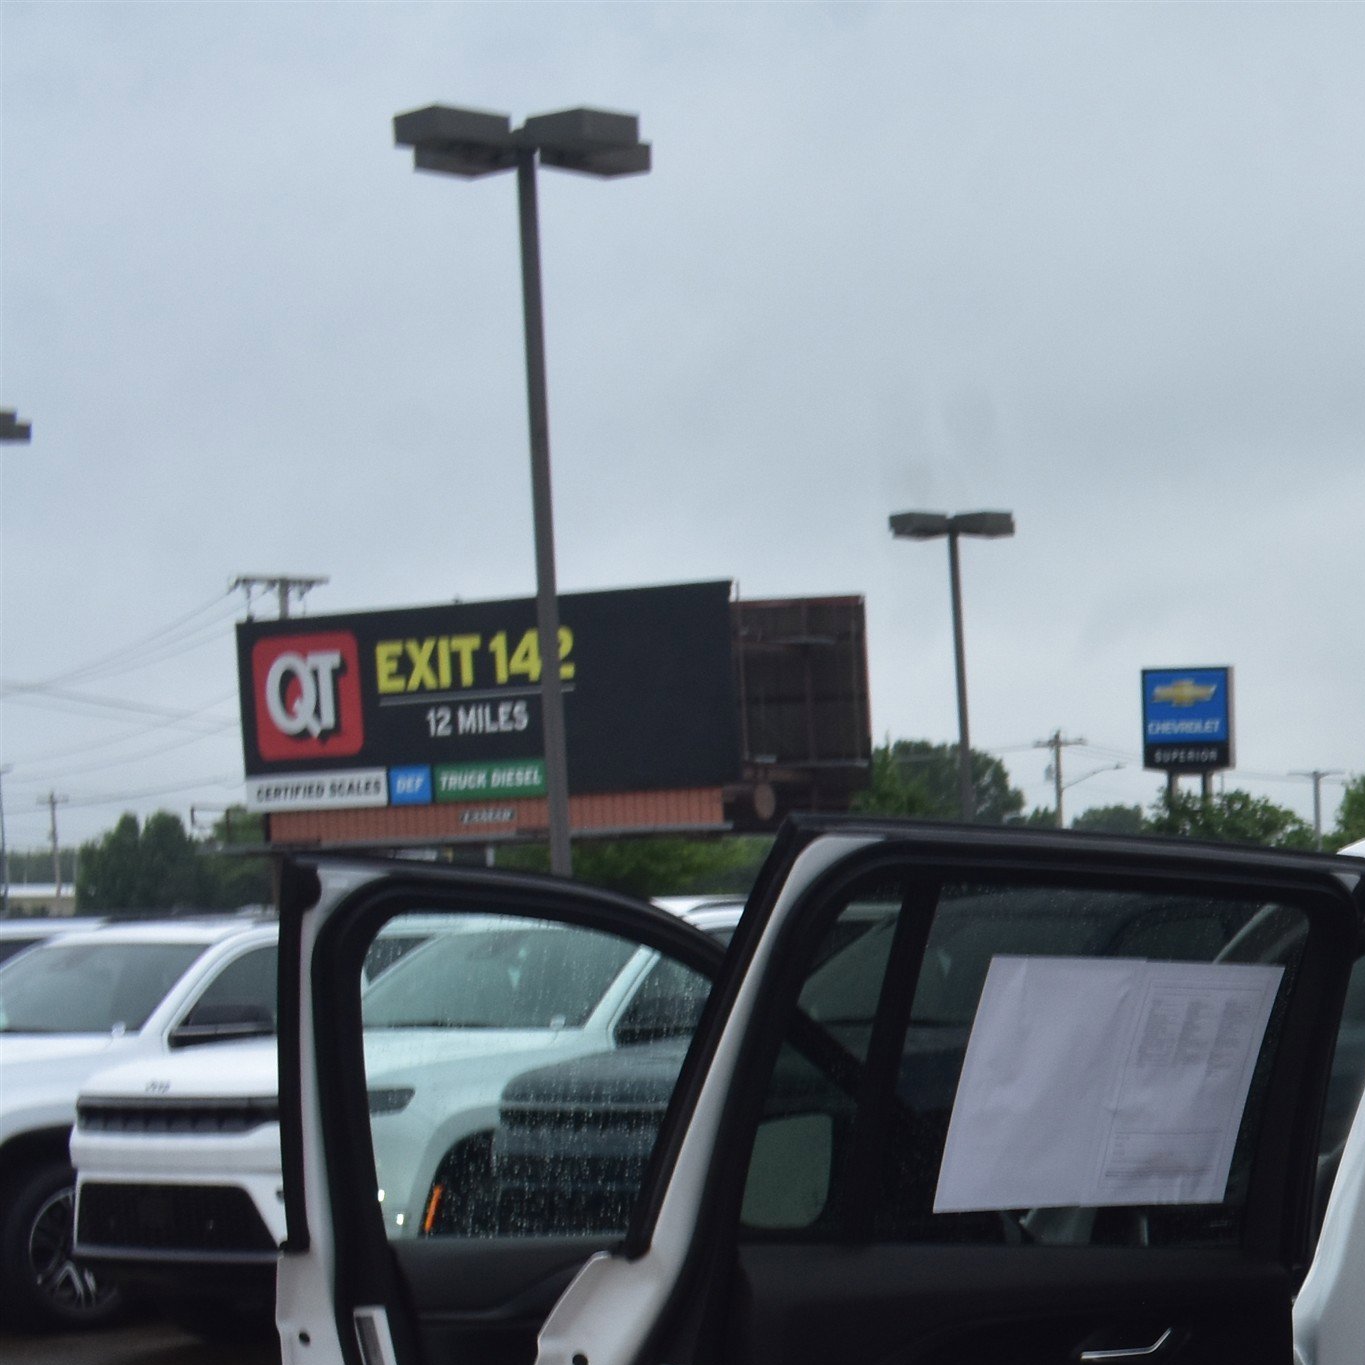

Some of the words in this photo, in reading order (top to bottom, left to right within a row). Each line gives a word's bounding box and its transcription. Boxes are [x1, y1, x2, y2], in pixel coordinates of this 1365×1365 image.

[375, 634, 480, 694] EXIT
[265, 651, 341, 740] QT
[425, 706, 452, 737] 12
[457, 701, 528, 735] MILES
[1148, 718, 1220, 734] CHEVROLET
[1155, 750, 1217, 762] SUPERIOR
[395, 775, 426, 794] DEF
[440, 770, 487, 791] TRUCK
[491, 766, 541, 786] DIESEL
[256, 782, 324, 803] CERTIFIED
[329, 779, 381, 798] SCALES
